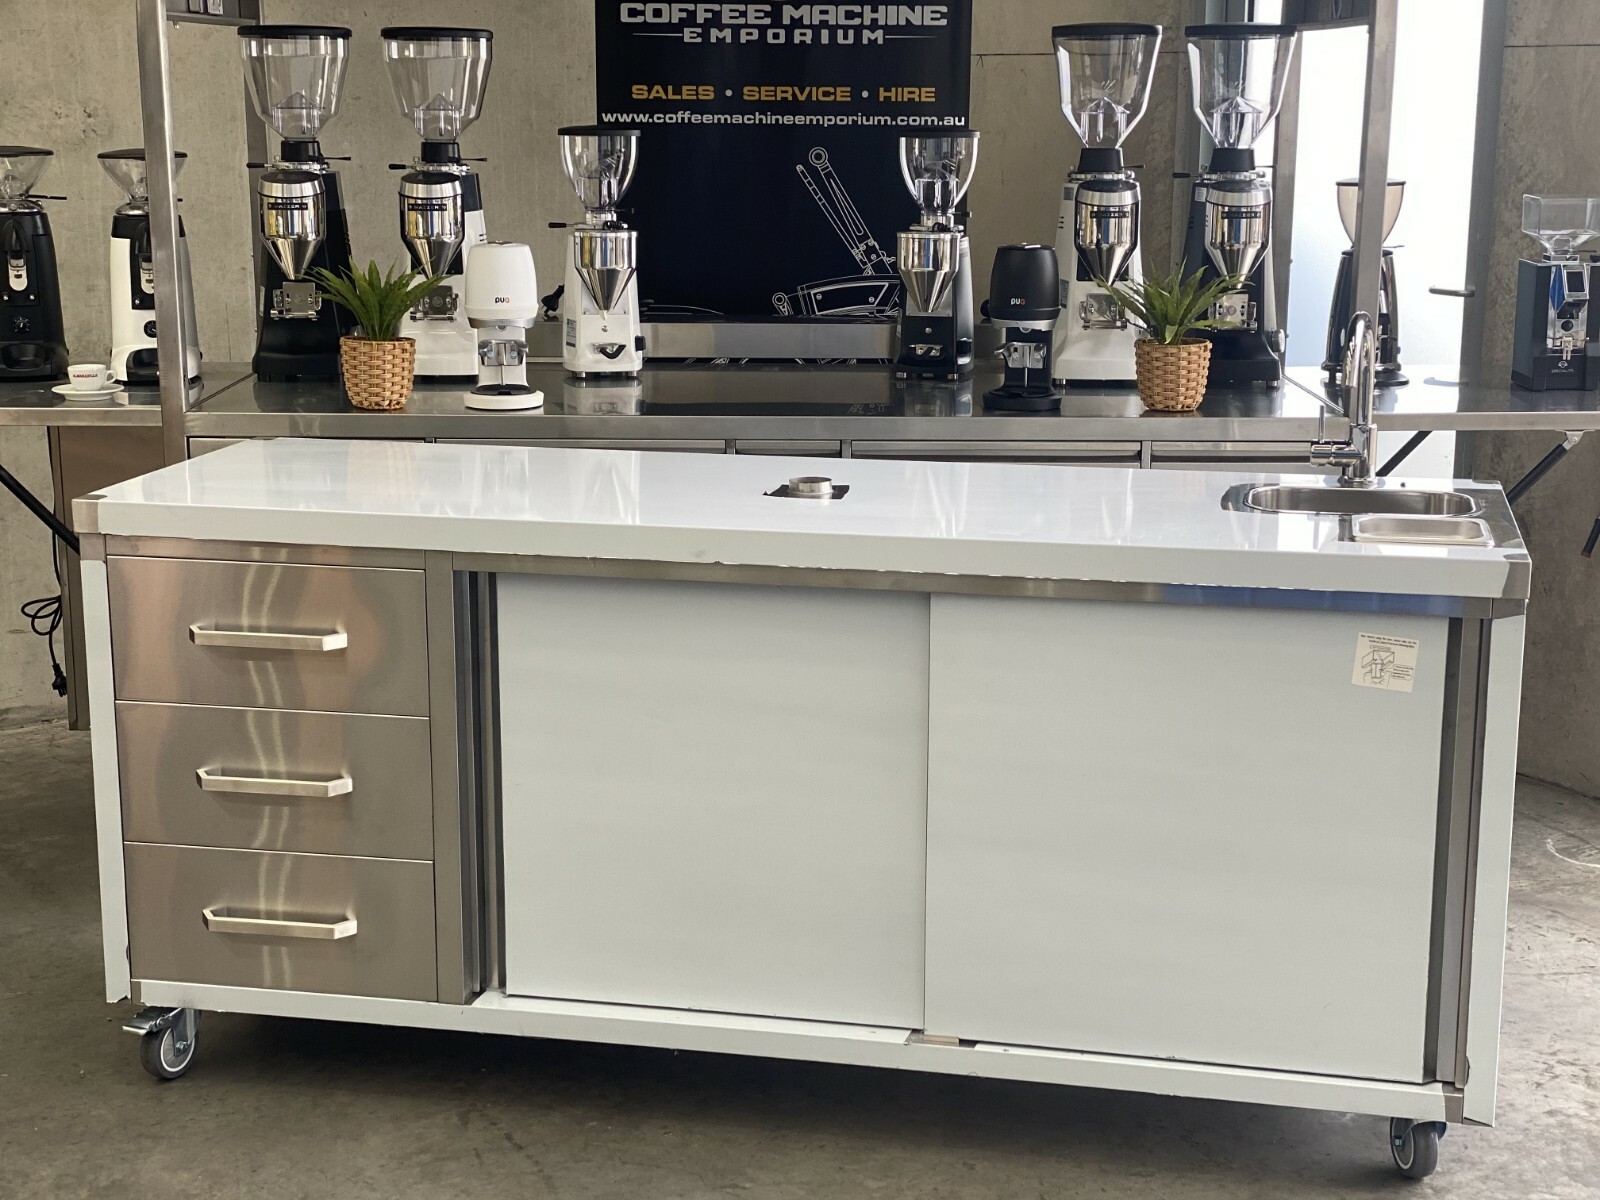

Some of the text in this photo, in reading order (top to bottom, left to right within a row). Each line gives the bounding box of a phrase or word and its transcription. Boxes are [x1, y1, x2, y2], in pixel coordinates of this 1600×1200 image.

[620, 3, 948, 26] COFFEE MACHINE
[683, 27, 884, 44] EMPORIUM
[631, 84, 936, 102] SALES SERVICE HIRE
[601, 110, 965, 127] www.coffeemachineemporium.com.au
